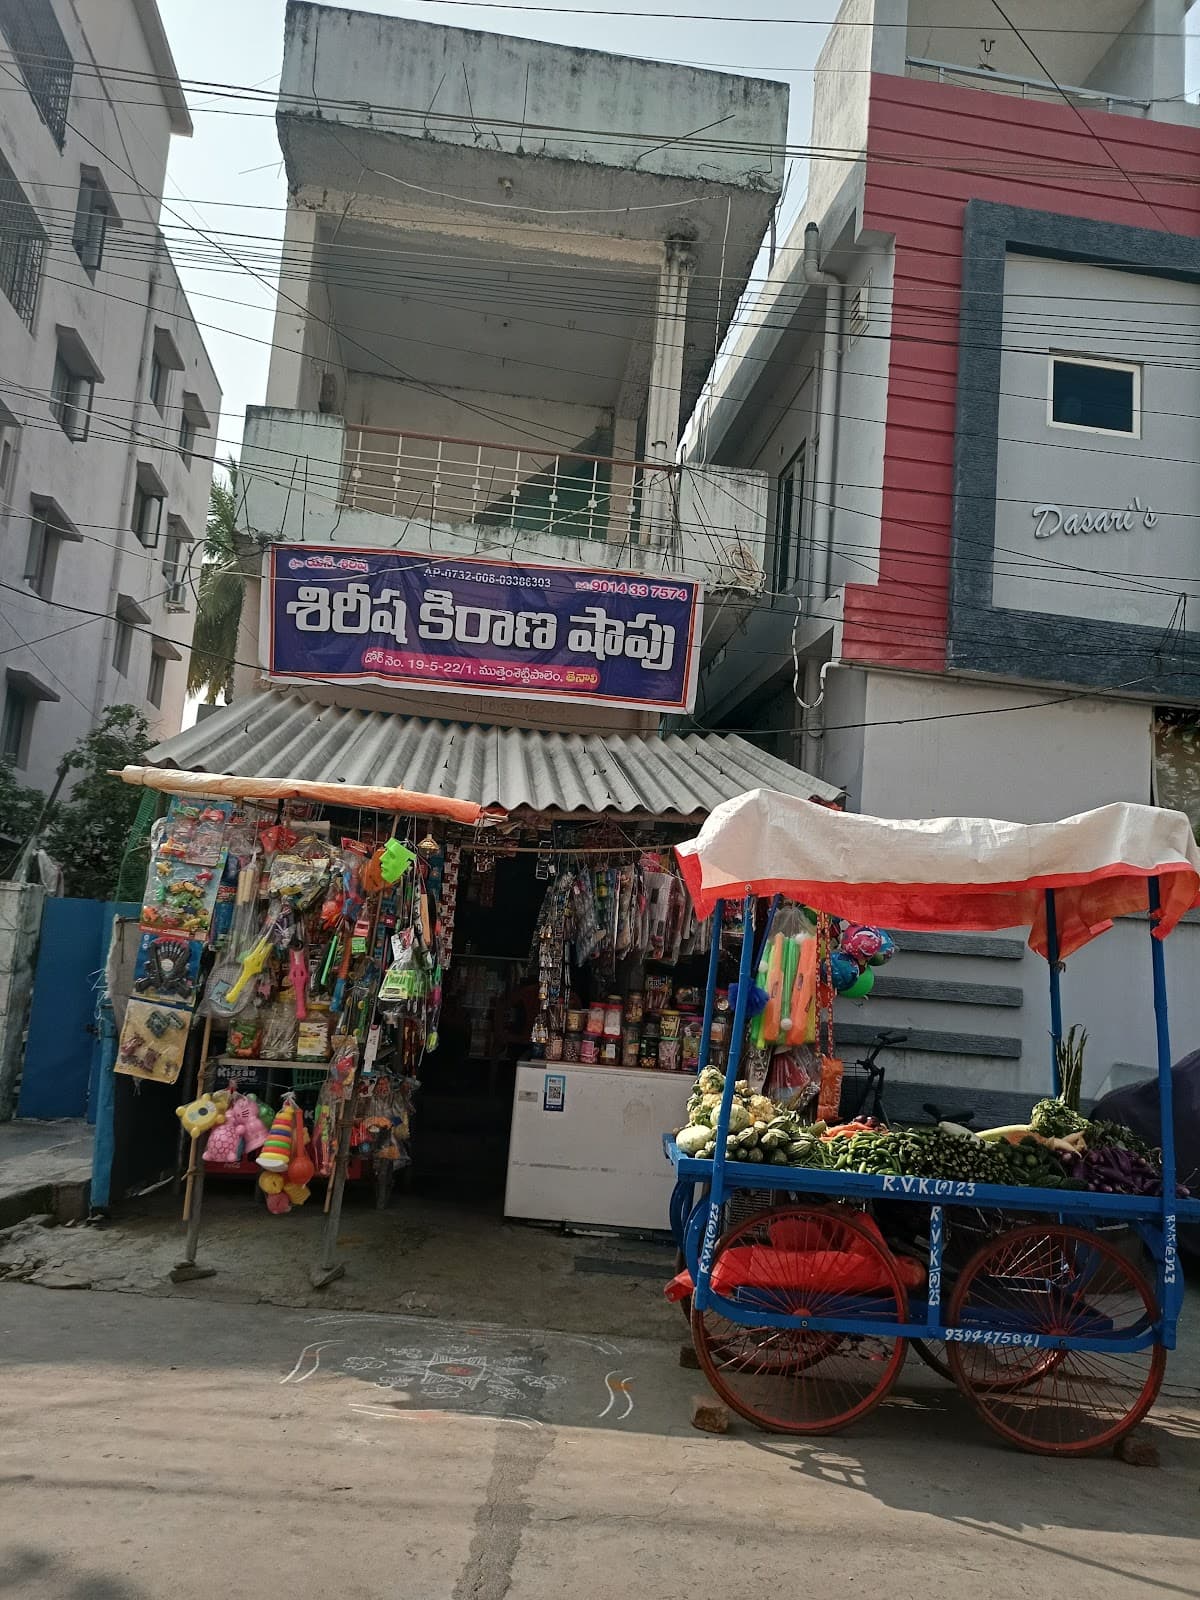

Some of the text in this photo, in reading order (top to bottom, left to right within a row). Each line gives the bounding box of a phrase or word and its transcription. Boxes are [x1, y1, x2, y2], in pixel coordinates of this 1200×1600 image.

[1032, 496, 1159, 539] Dasari's
[591, 579, 627, 594] 9014
[629, 583, 648, 597] 33
[650, 585, 688, 602] 7574
[286, 582, 676, 671] శిరీష కిరాణ షాపు
[944, 1328, 1040, 1348] 9394475841
